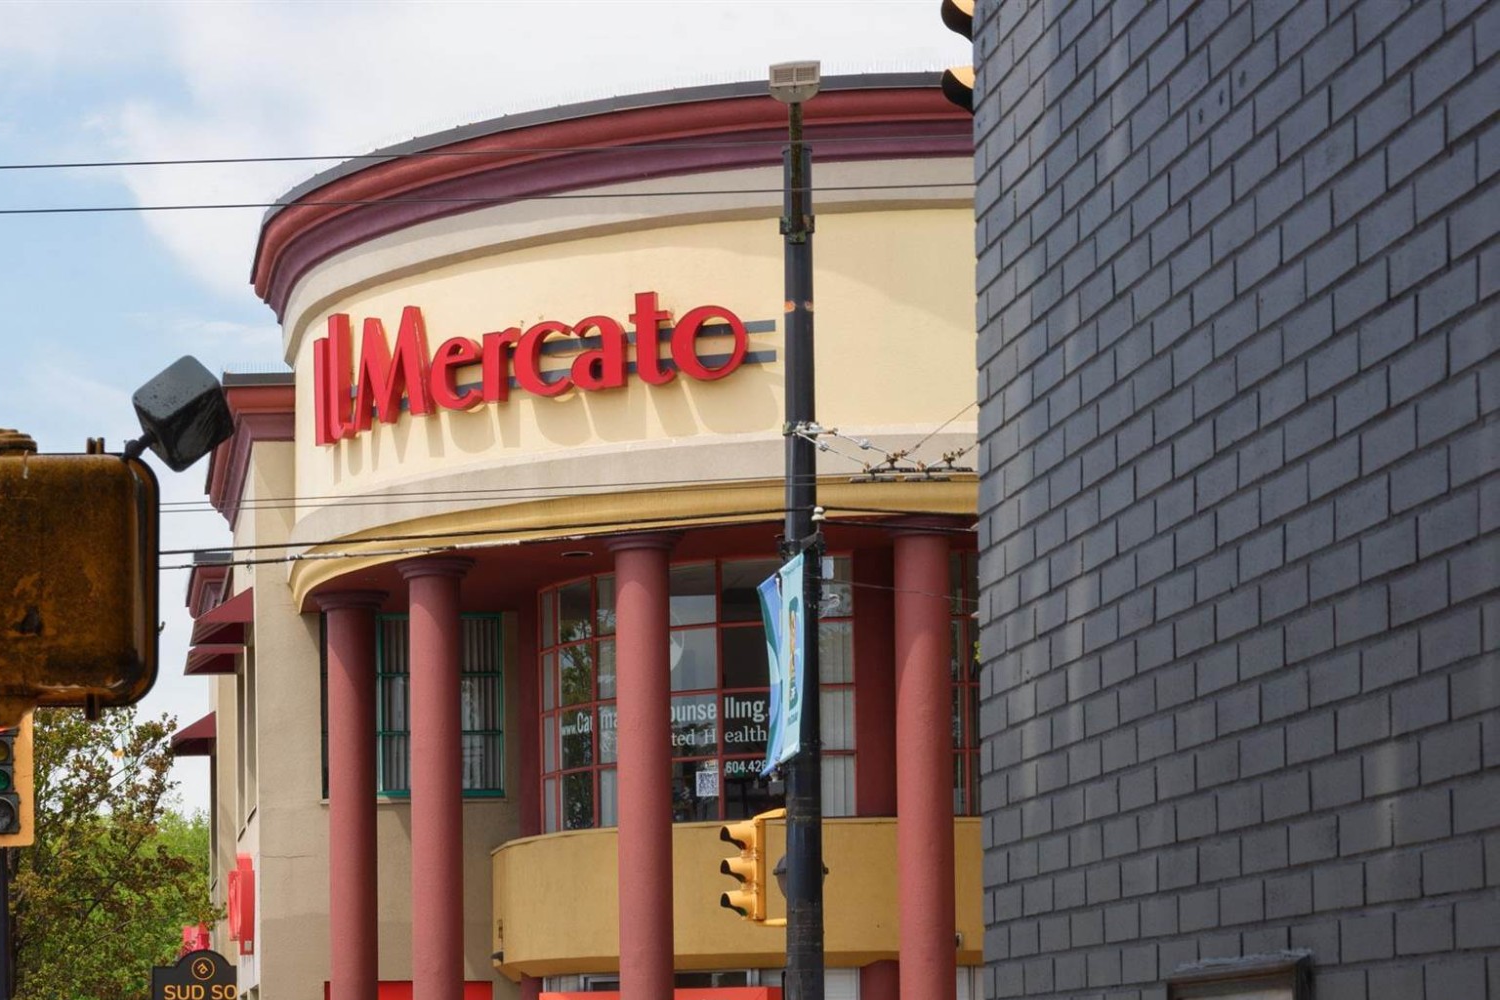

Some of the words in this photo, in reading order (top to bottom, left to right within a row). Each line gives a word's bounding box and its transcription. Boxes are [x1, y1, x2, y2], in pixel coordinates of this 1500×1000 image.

[354, 291, 748, 431] Mercato
[704, 725, 767, 745] Health
[164, 985, 205, 1000] SUD
